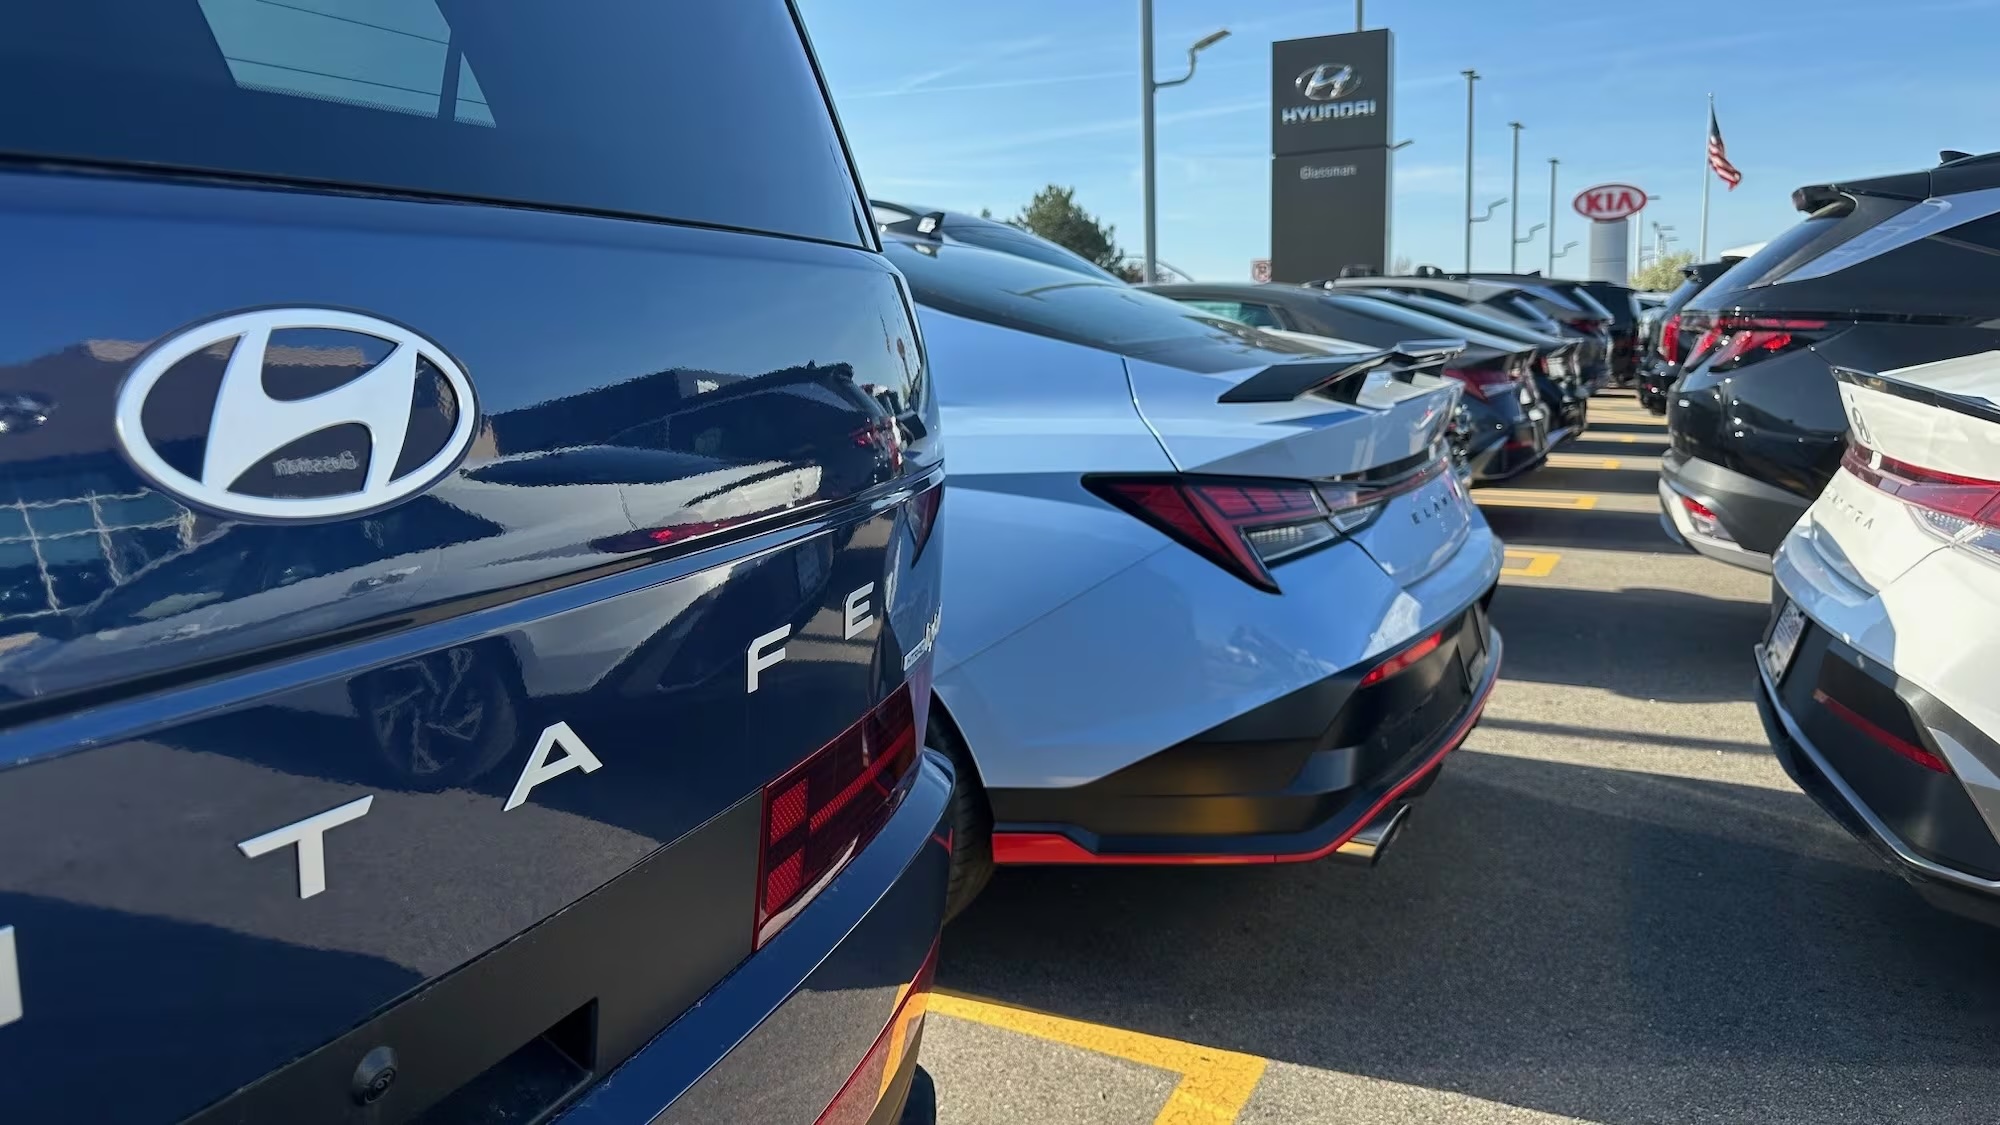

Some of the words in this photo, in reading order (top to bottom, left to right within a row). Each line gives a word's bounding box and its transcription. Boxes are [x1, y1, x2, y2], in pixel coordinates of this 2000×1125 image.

[1282, 99, 1376, 124] HYUNDAI
[1585, 191, 1634, 214] KIA
[745, 581, 875, 693] FE
